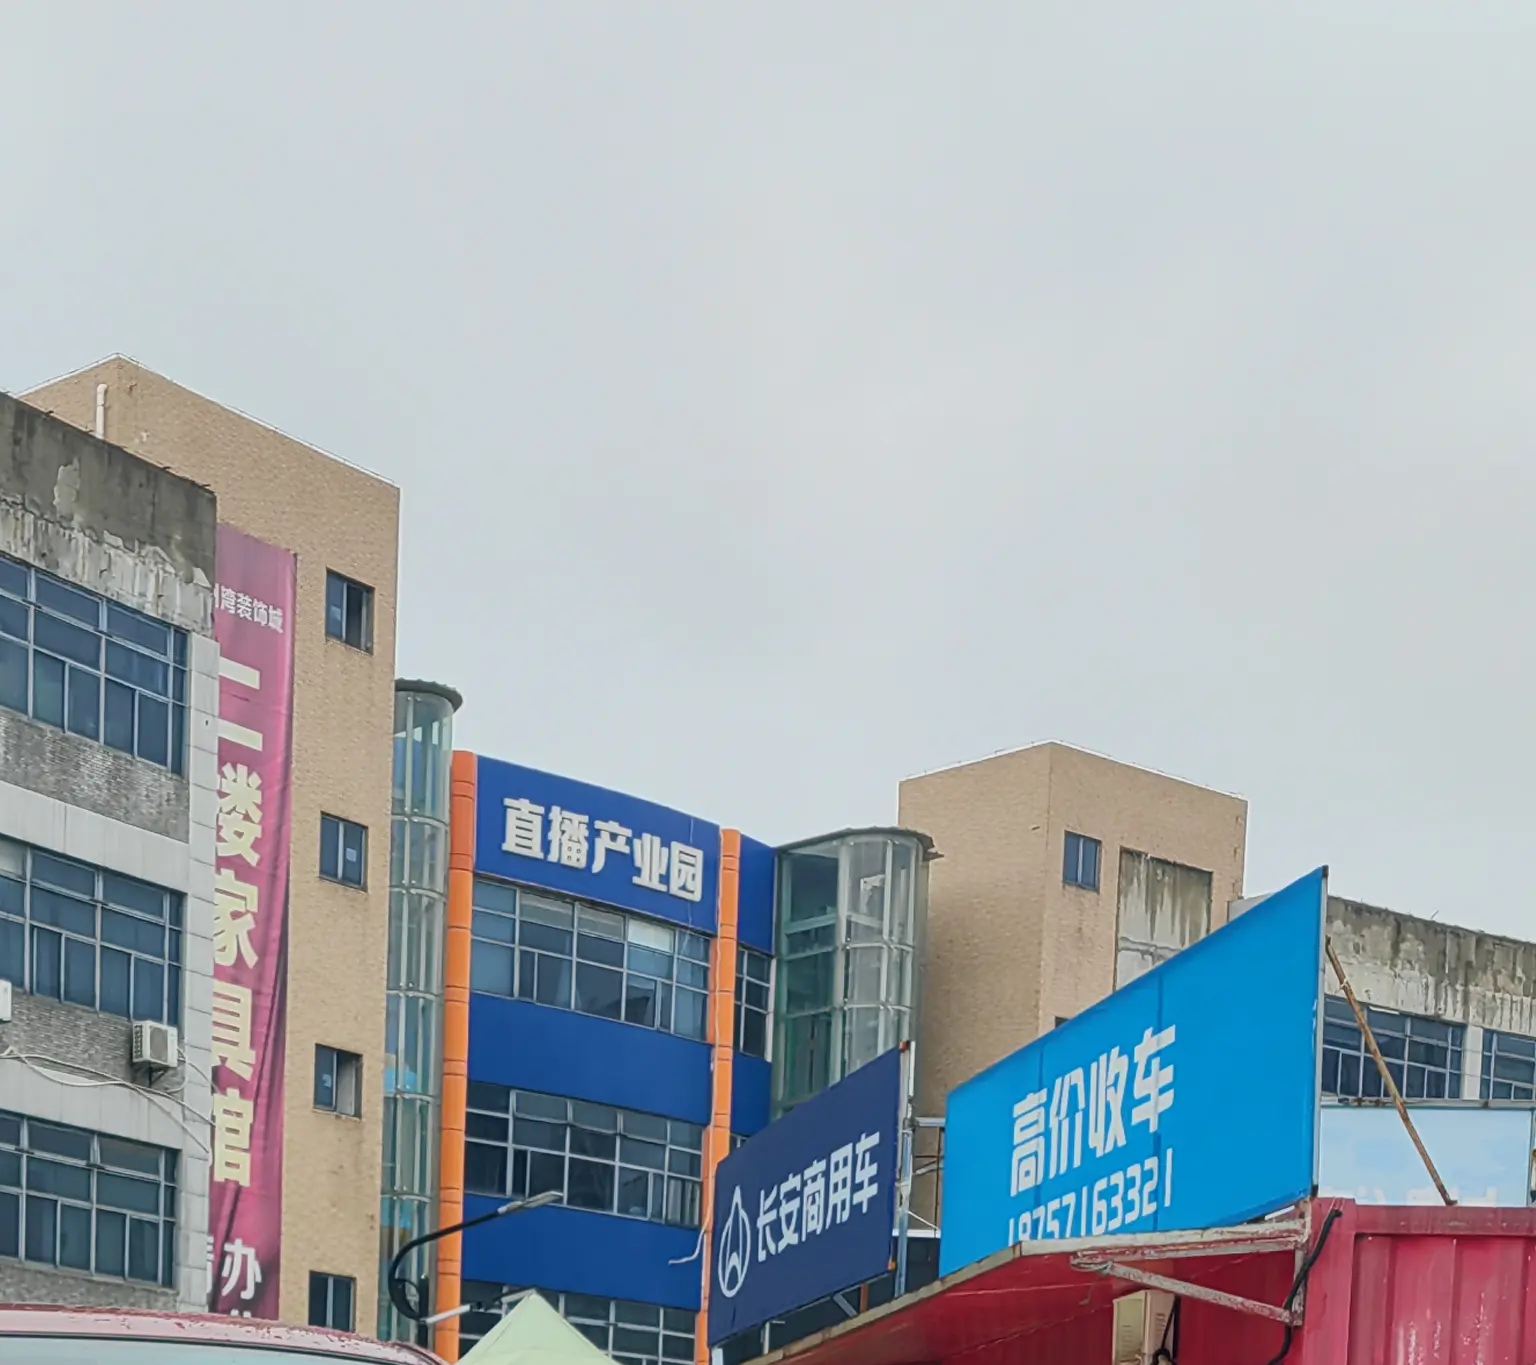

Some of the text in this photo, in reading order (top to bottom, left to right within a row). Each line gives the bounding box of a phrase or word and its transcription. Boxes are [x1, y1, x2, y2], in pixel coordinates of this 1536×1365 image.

[502, 798, 703, 902] 直播产业园
[1010, 1024, 1176, 1198] 高价收车
[756, 1131, 880, 1263] 长安商用车
